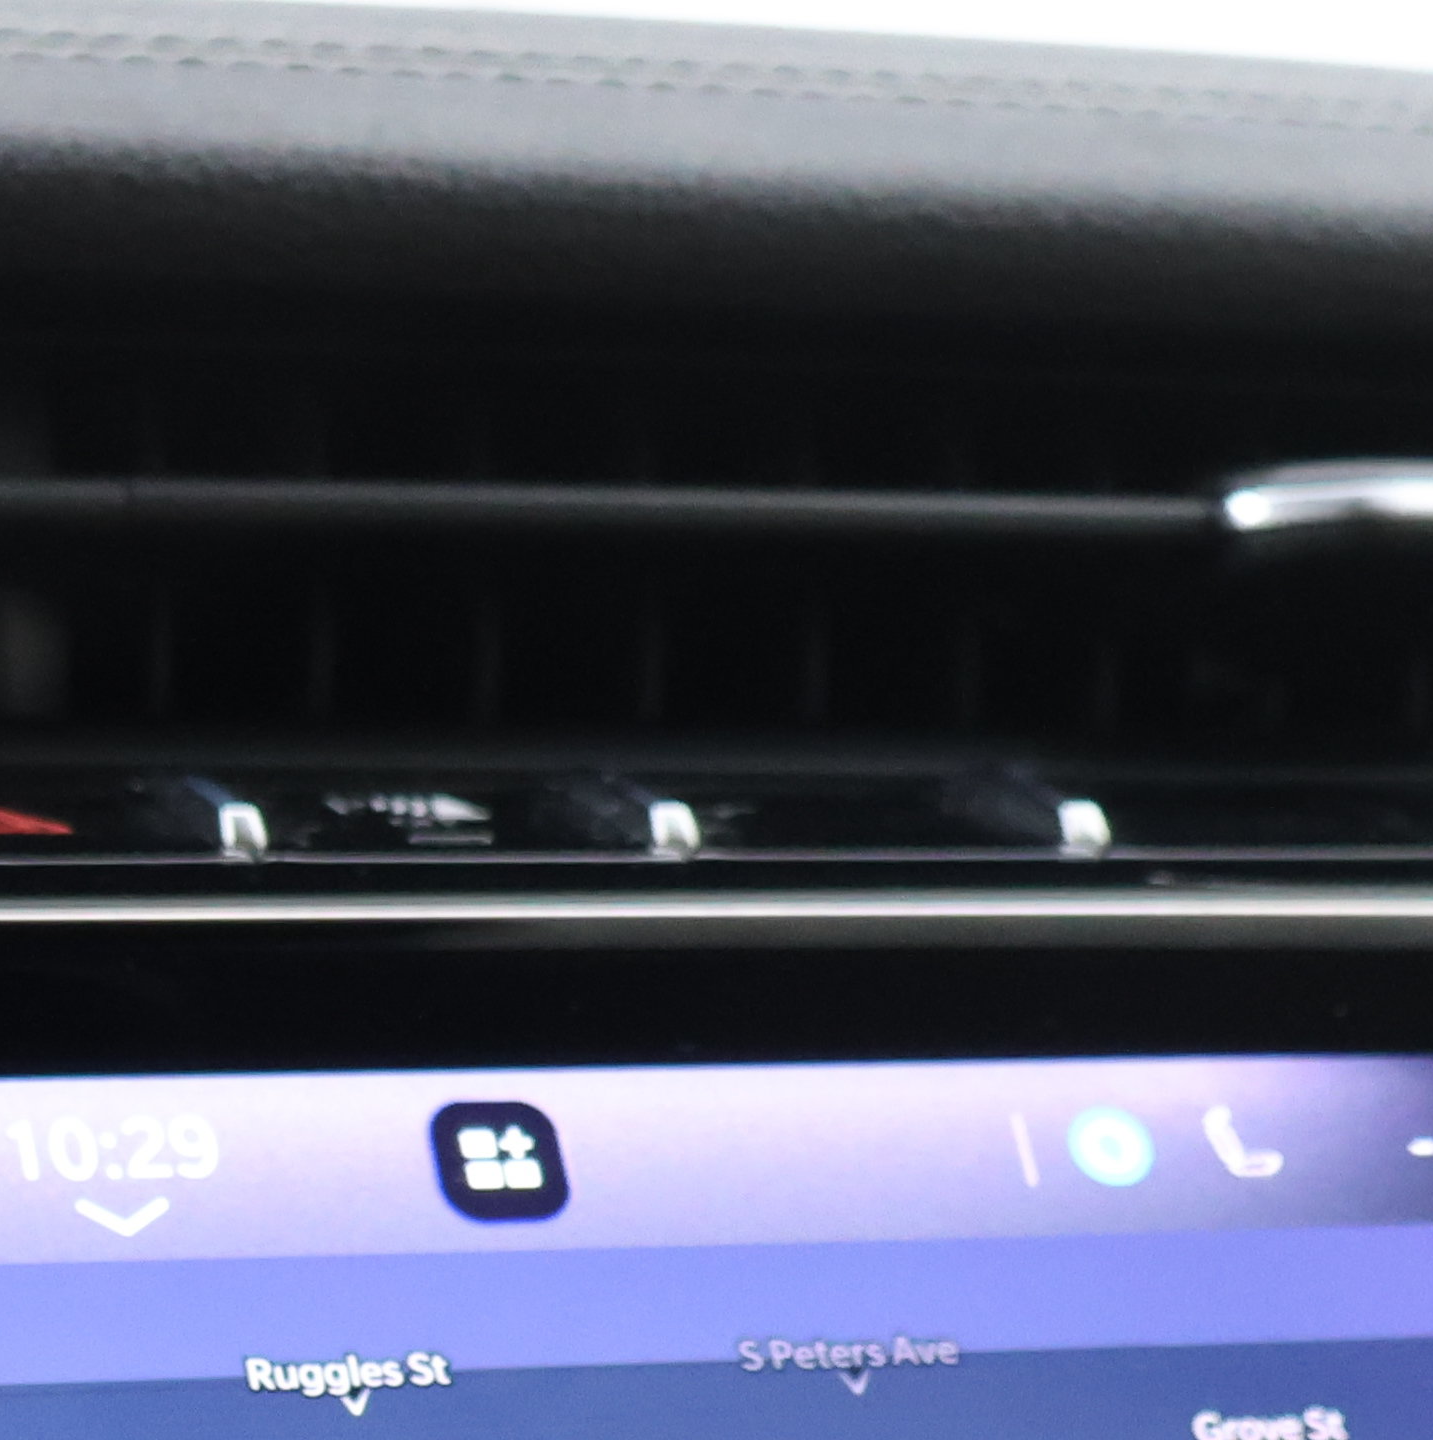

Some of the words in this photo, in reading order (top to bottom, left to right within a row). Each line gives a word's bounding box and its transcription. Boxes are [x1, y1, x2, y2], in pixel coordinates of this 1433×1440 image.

[6, 1114, 220, 1182] 10:29
[245, 1354, 404, 1397] Ruggles
[406, 1352, 452, 1386] St
[739, 1341, 764, 1371] S
[769, 1339, 887, 1370] Peters
[893, 1336, 960, 1366] Ave
